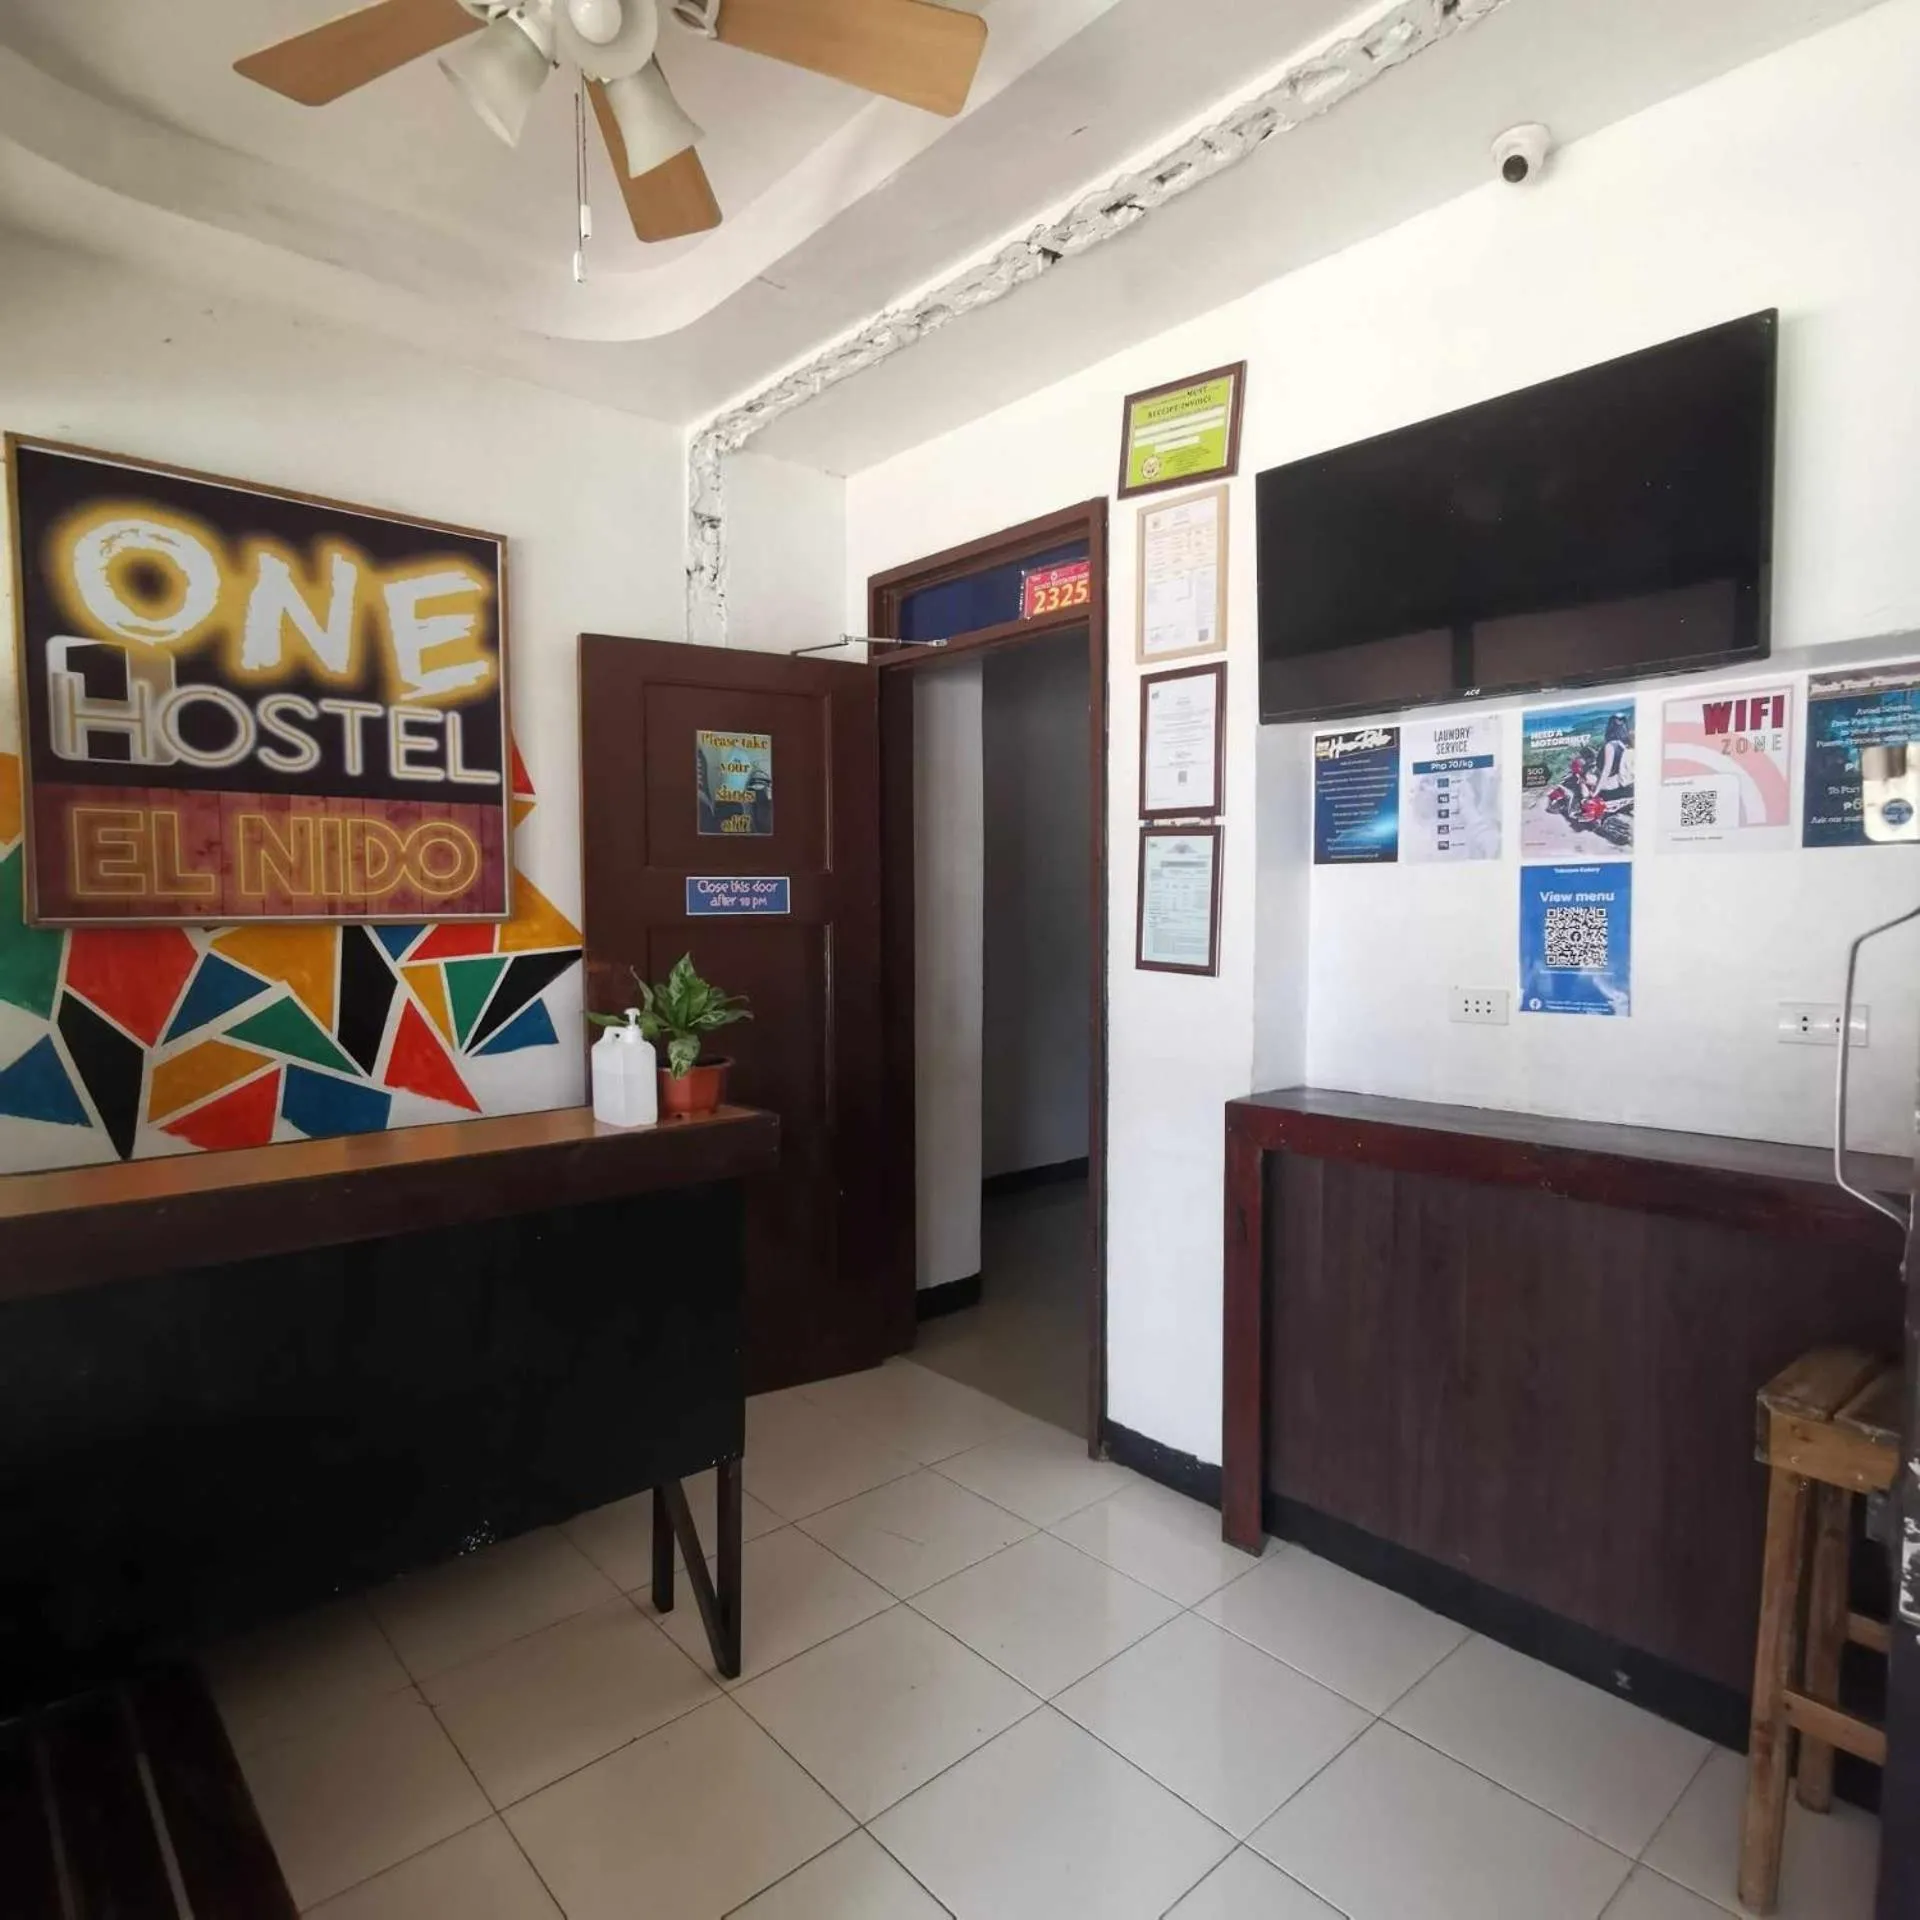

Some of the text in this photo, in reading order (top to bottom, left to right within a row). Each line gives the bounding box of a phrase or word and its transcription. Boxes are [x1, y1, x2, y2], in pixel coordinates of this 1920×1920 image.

[1032, 579, 1088, 615] 2325
[73, 518, 491, 699] ONE
[46, 634, 501, 784] HOSTEL
[1702, 695, 1784, 735] WIFI
[701, 733, 768, 750] Please take
[1434, 727, 1471, 742] LAUNDRY
[1436, 740, 1468, 755] SERVICE
[1721, 734, 1782, 755] ZONE
[719, 761, 750, 775] your
[72, 806, 479, 896] EL NIDO
[697, 880, 778, 893] Close this door
[710, 895, 737, 907] after
[1539, 891, 1615, 903] View menu
